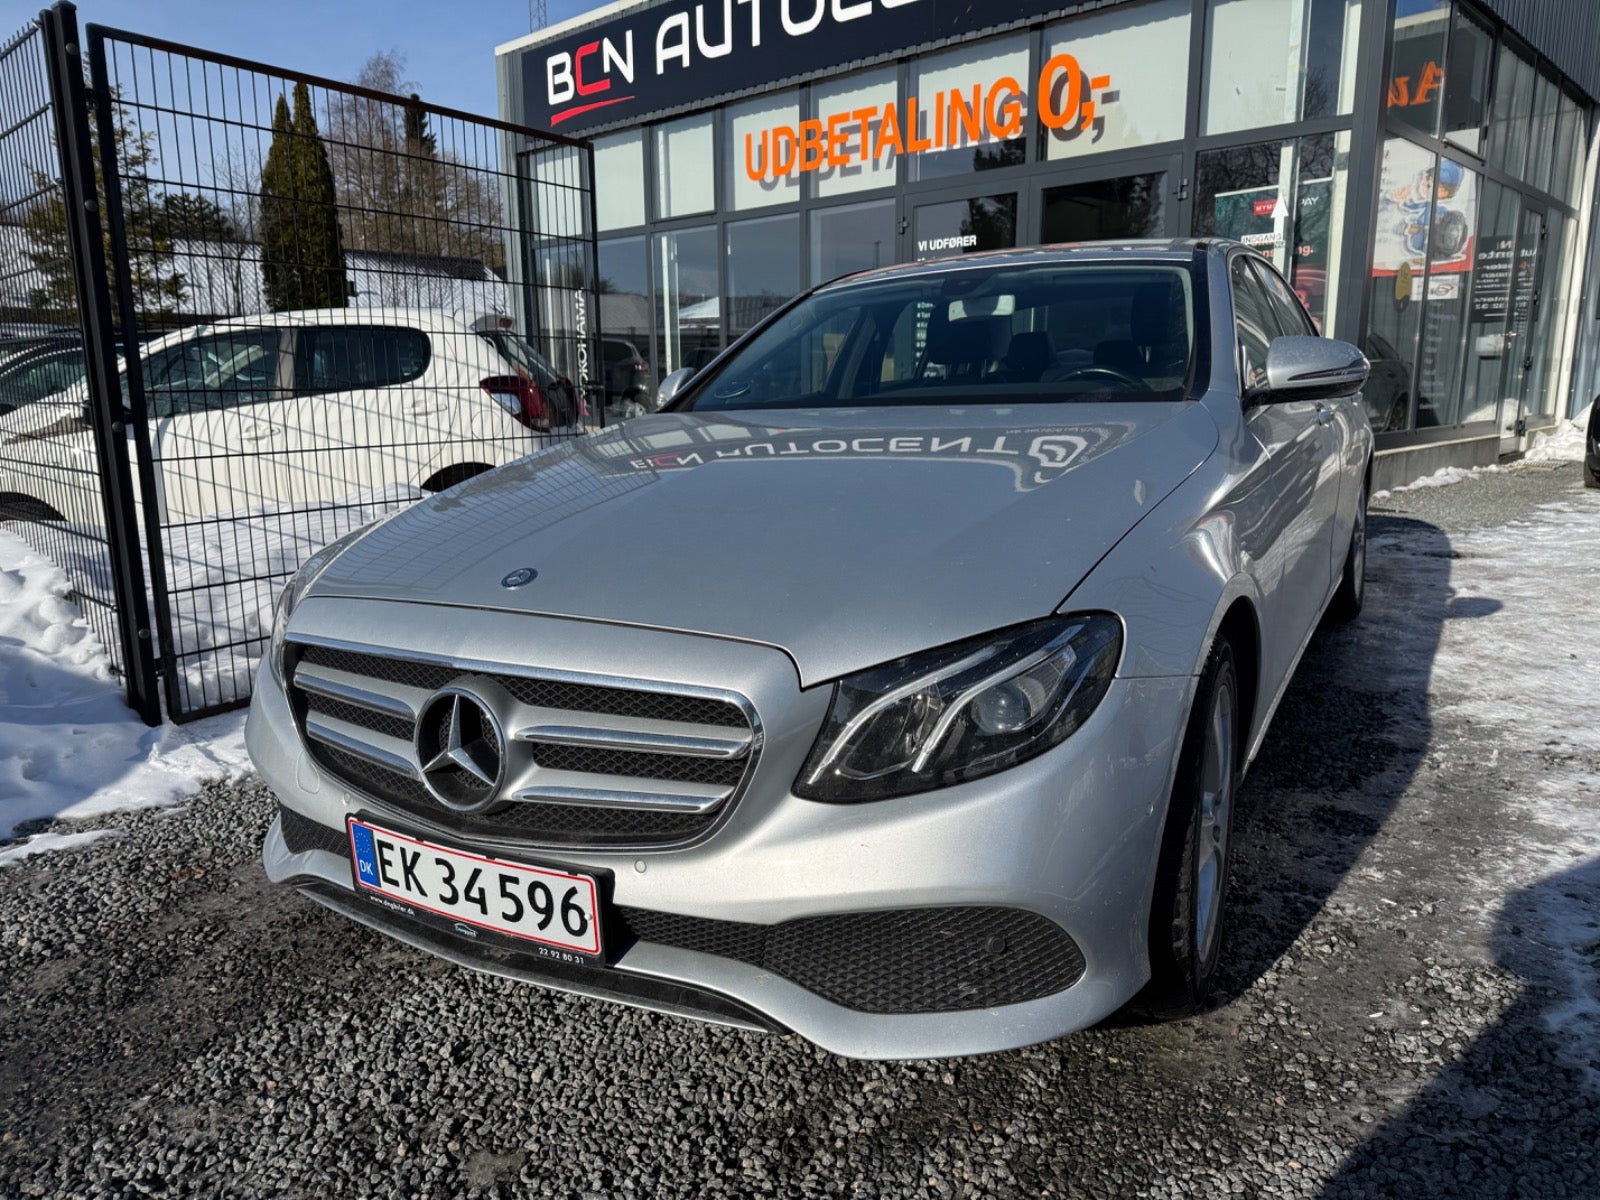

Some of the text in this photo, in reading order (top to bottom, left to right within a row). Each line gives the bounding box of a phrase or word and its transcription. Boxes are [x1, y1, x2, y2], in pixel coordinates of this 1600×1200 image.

[547, 29, 635, 106] BCN
[744, 77, 1021, 182] UDBETALING
[918, 235, 977, 252] VI UDFØRER
[360, 860, 374, 876] DK
[377, 839, 588, 937] EK 34 596
[539, 947, 549, 956] 22
[550, 950, 562, 959] 92
[575, 955, 584, 964] 31
